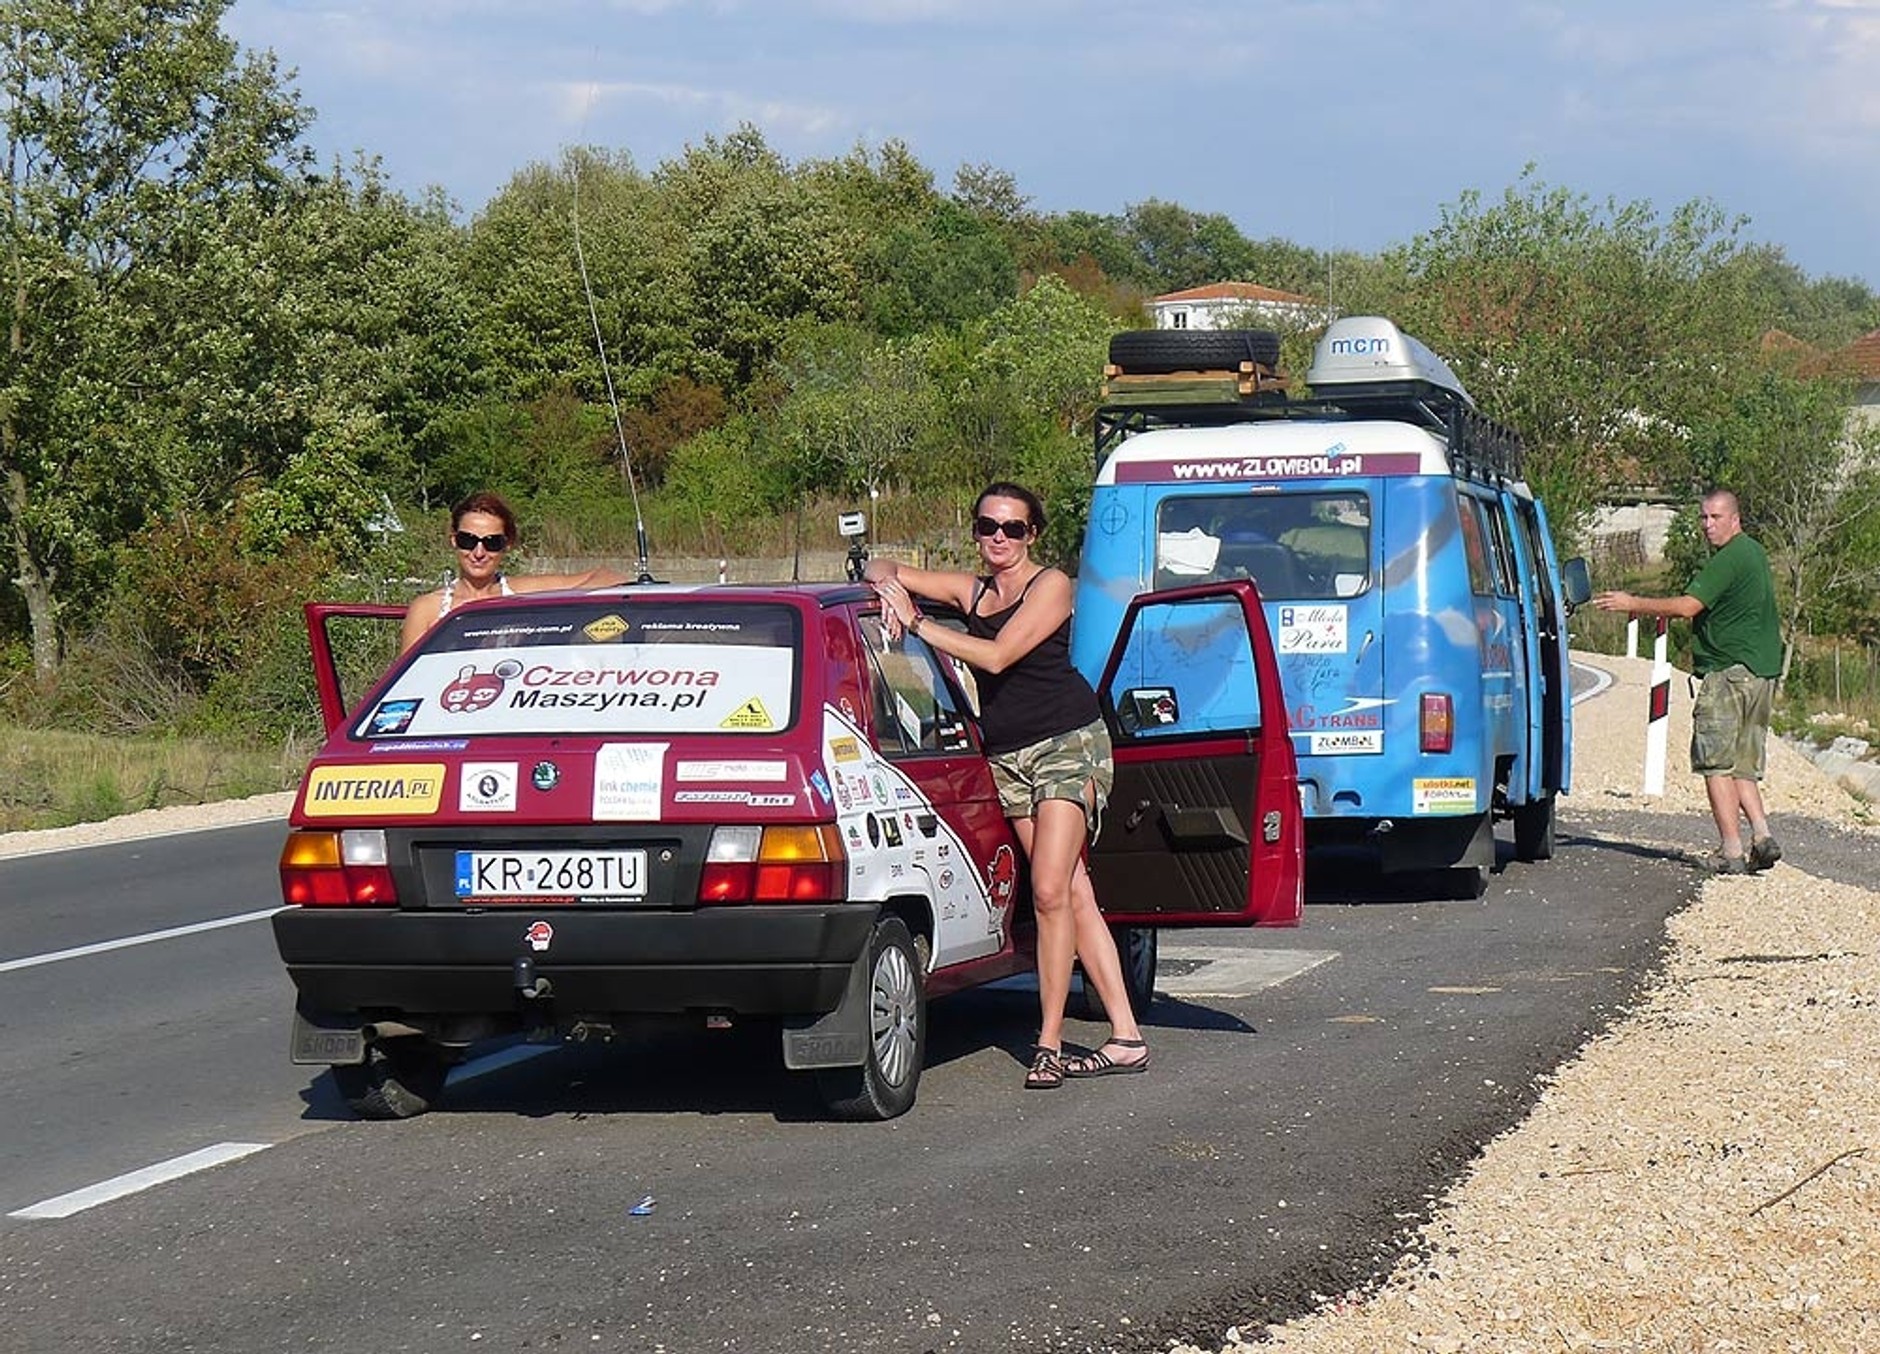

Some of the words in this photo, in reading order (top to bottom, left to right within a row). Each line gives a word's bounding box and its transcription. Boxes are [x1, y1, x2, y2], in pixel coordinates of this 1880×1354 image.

[1332, 338, 1389, 353] mcm
[641, 622, 684, 630] reklama
[522, 666, 720, 687] Czerwona
[509, 689, 707, 712] Maszyna.pl
[1320, 714, 1378, 728] TRANS
[620, 779, 658, 793] chemie
[477, 857, 523, 890] KR
[537, 857, 637, 889] 268TU
[459, 878, 471, 889] PL
